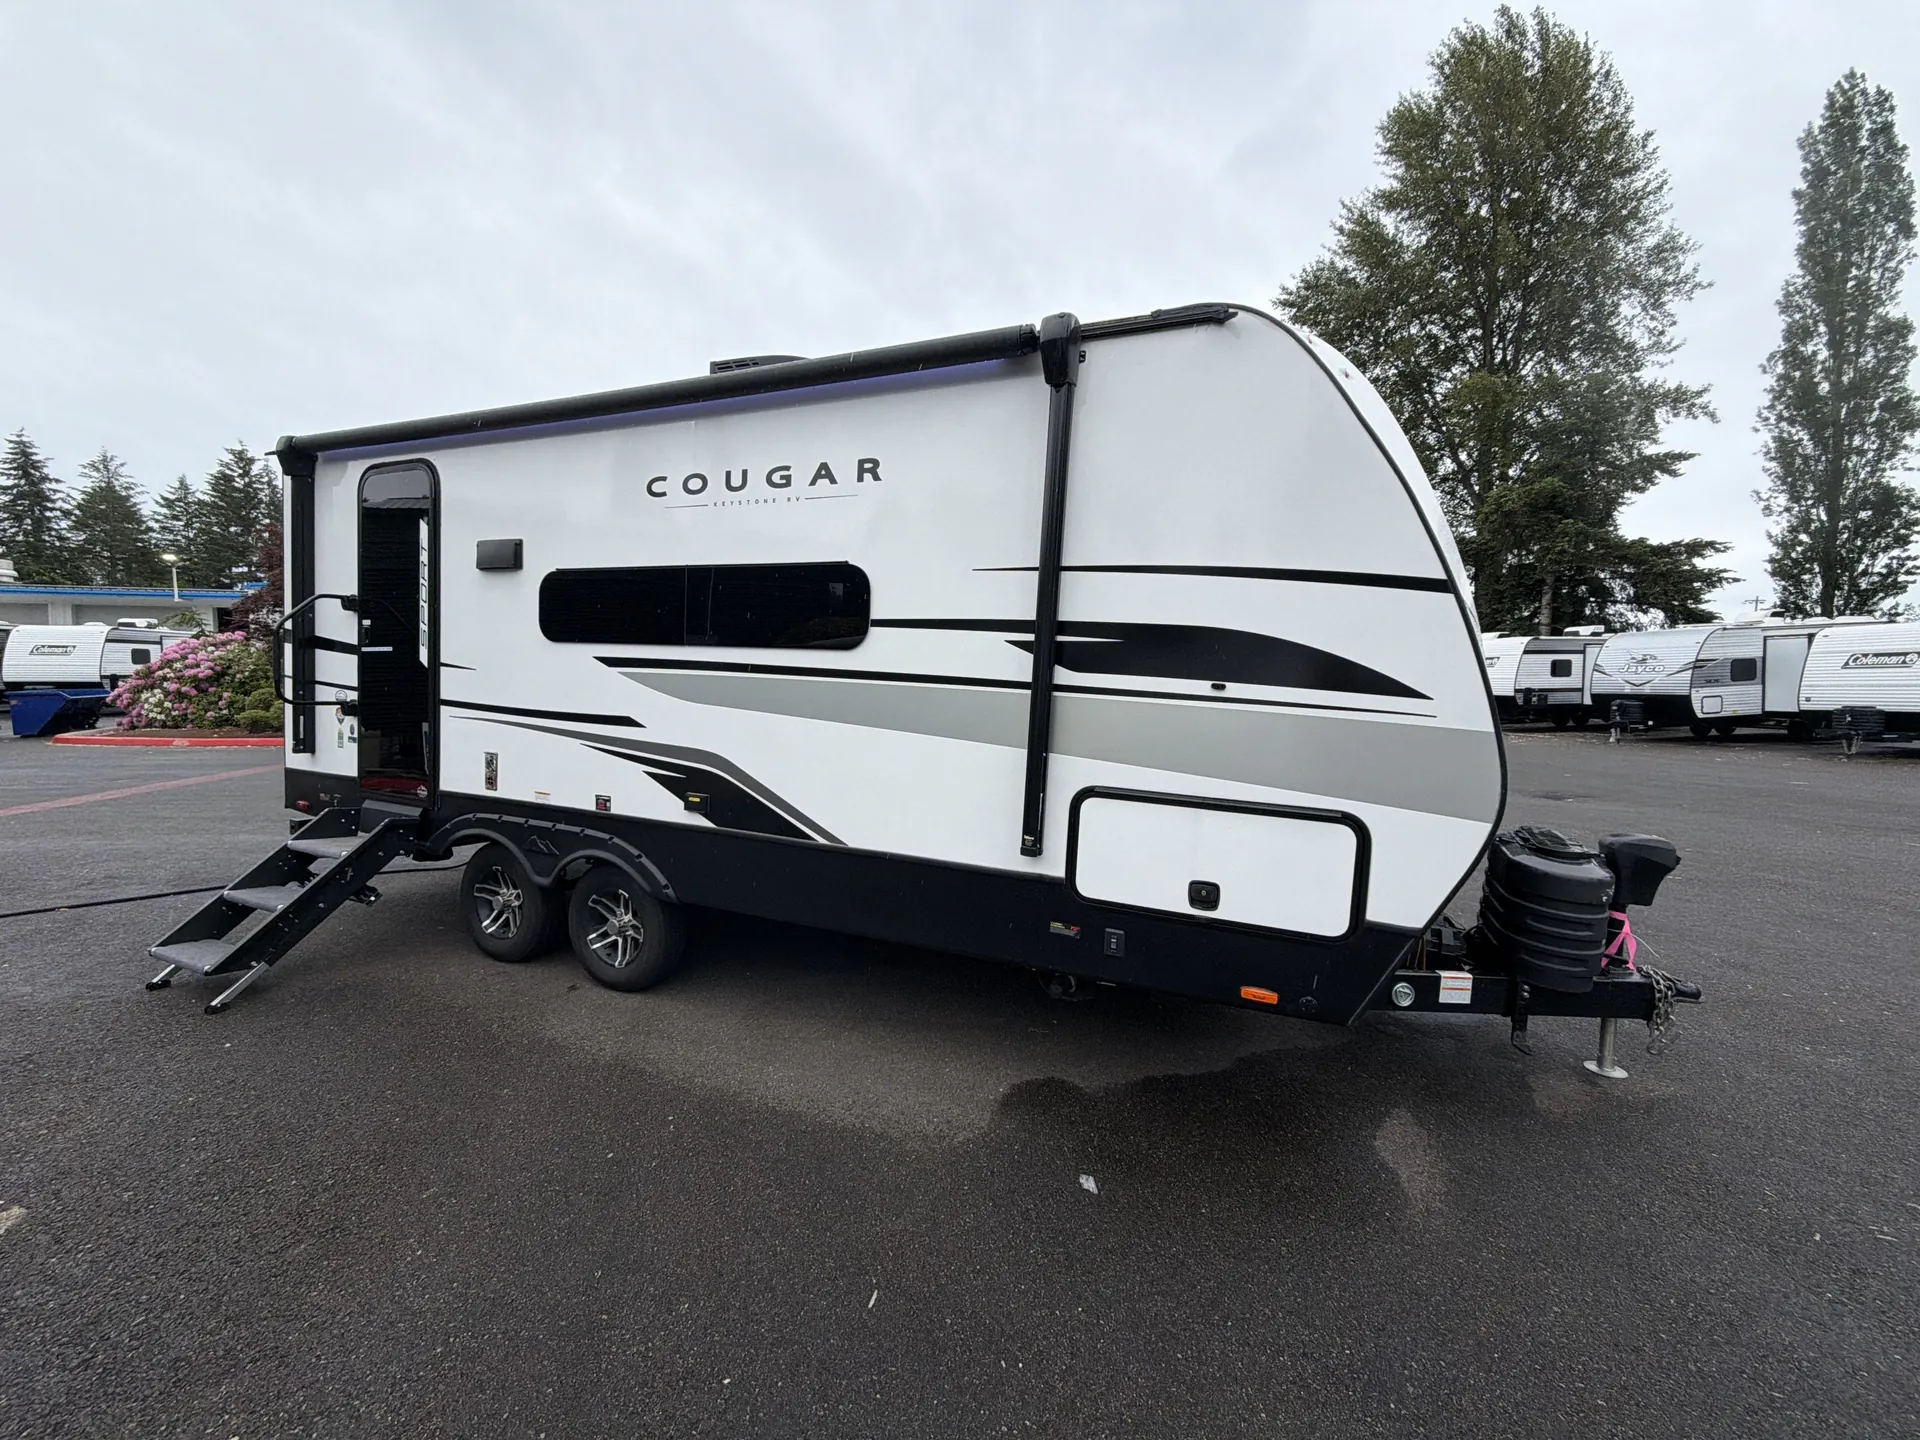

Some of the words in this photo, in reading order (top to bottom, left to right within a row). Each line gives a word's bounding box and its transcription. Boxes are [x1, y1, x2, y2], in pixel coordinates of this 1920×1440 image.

[646, 458, 882, 498] COUGAR
[713, 498, 777, 507] KEYSTONE
[420, 537, 428, 650] SPORT
[1848, 653, 1906, 666] Coleman
[1619, 663, 1665, 675] Jayco
